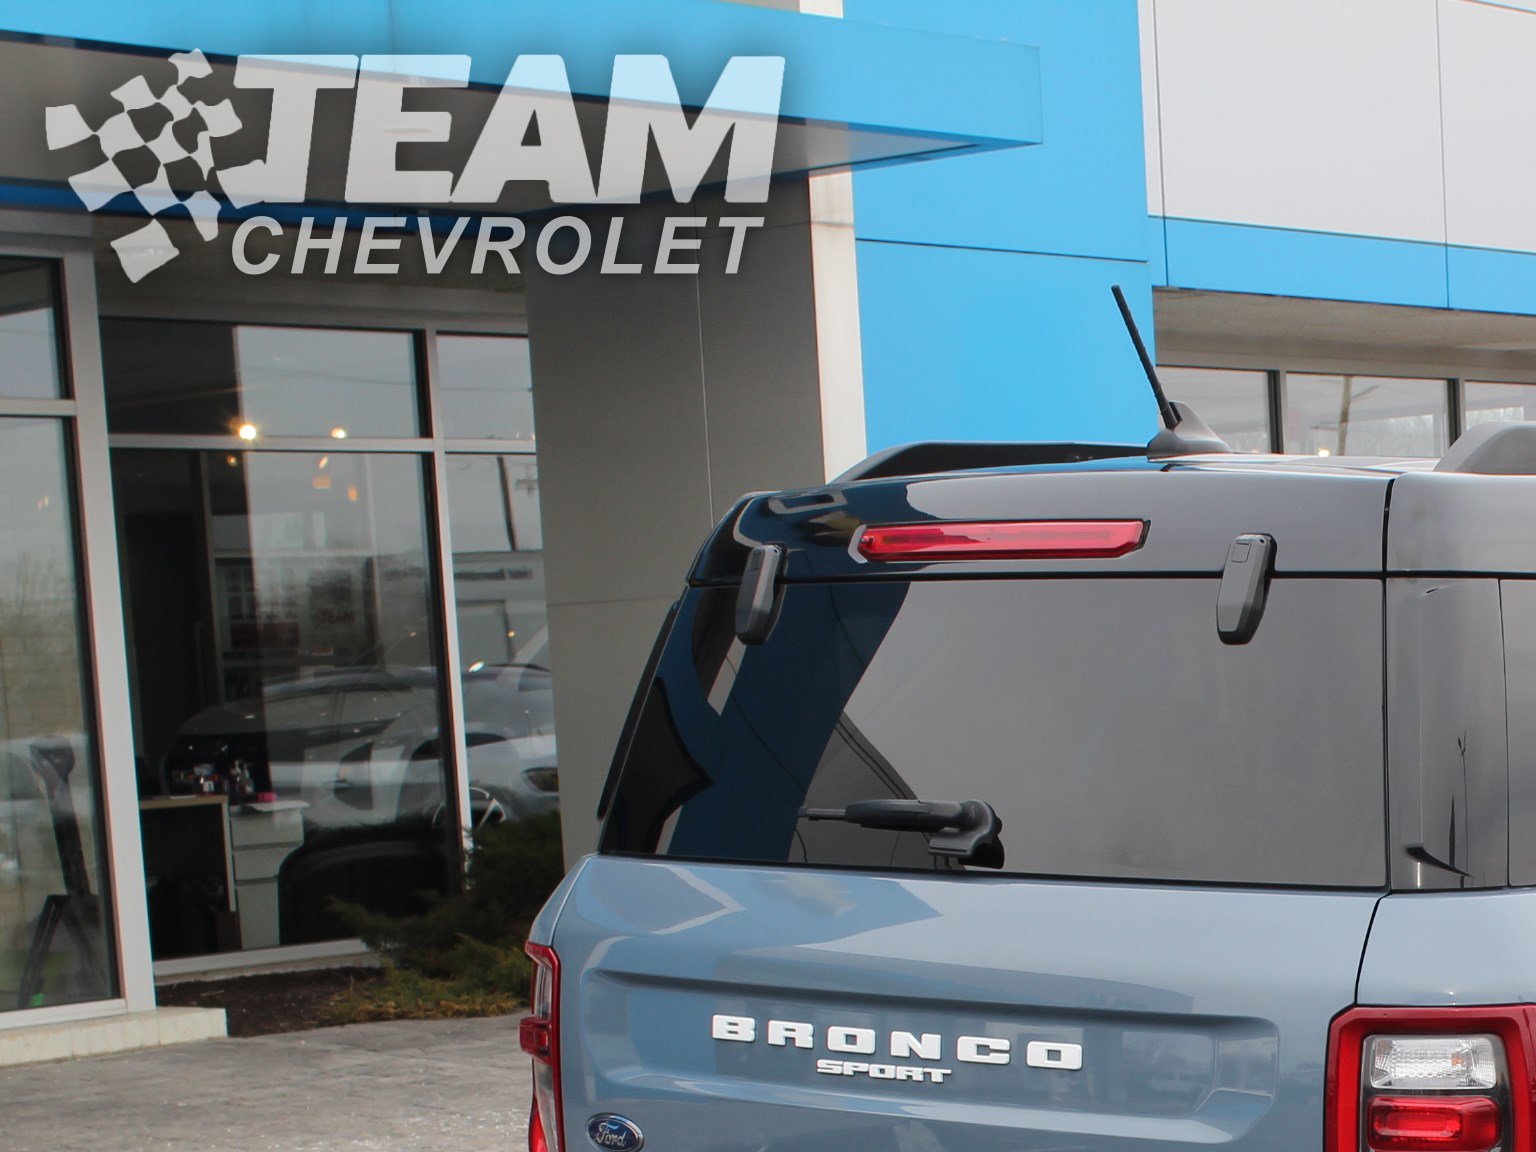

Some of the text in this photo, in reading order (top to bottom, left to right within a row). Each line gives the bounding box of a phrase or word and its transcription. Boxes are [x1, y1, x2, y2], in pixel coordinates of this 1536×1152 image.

[711, 1013, 1083, 1071] BRONCO
[816, 1059, 952, 1083] SPORT
[596, 1122, 627, 1147] Ford
